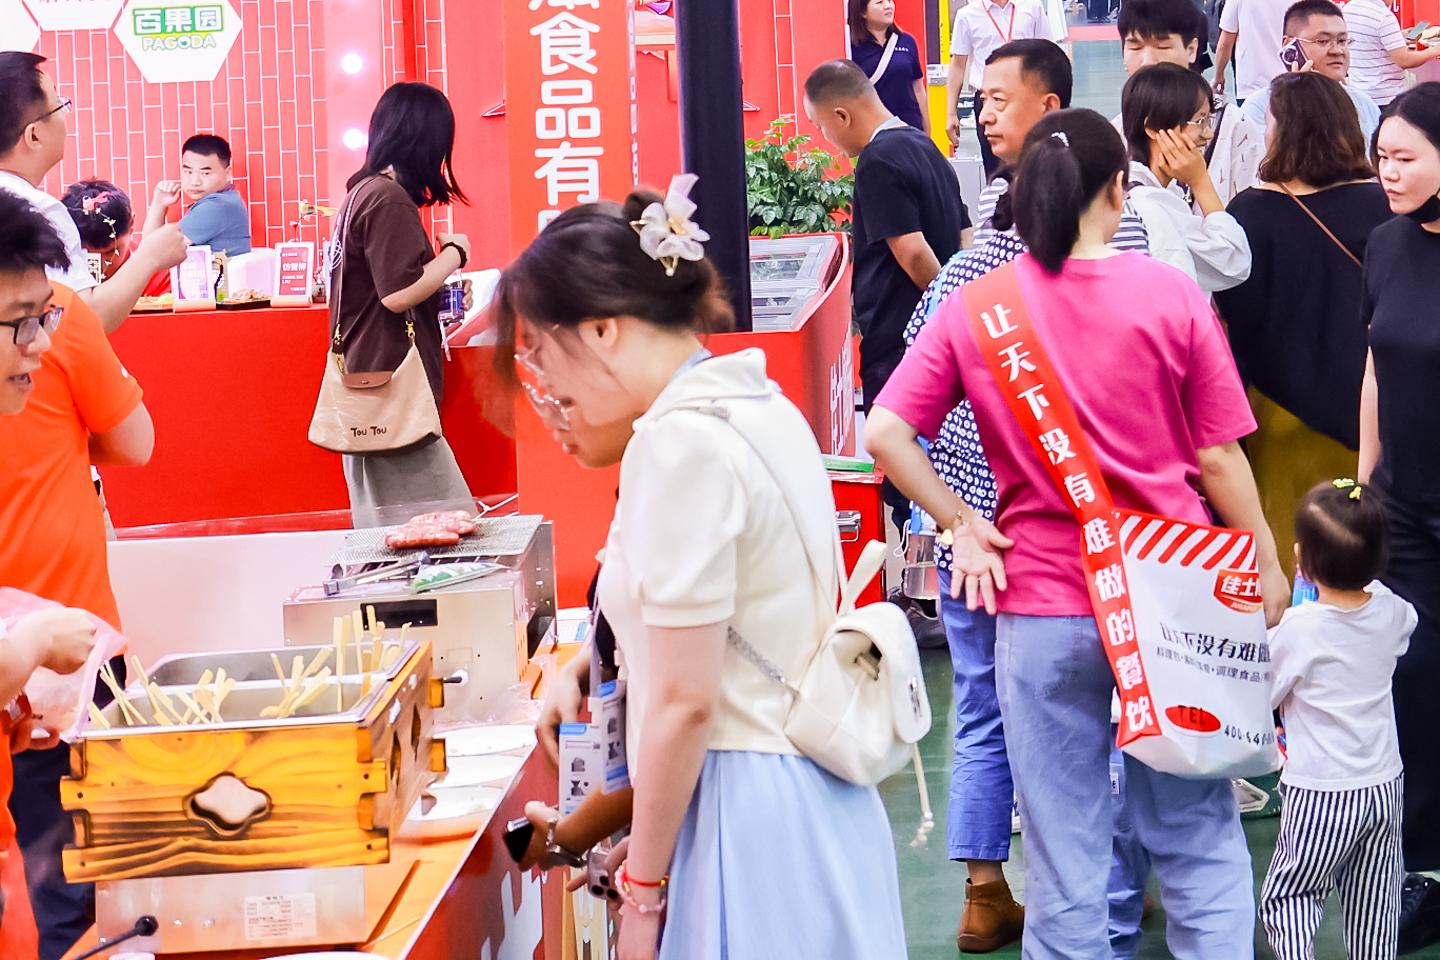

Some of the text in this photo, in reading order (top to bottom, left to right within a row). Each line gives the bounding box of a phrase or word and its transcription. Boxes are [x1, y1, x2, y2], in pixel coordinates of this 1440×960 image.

[133, 6, 223, 35] 百果园
[141, 34, 217, 51] PAGODA
[351, 426, 387, 437] Tou Tou
[980, 303, 1153, 735] 让天下没有难做的餐饮
